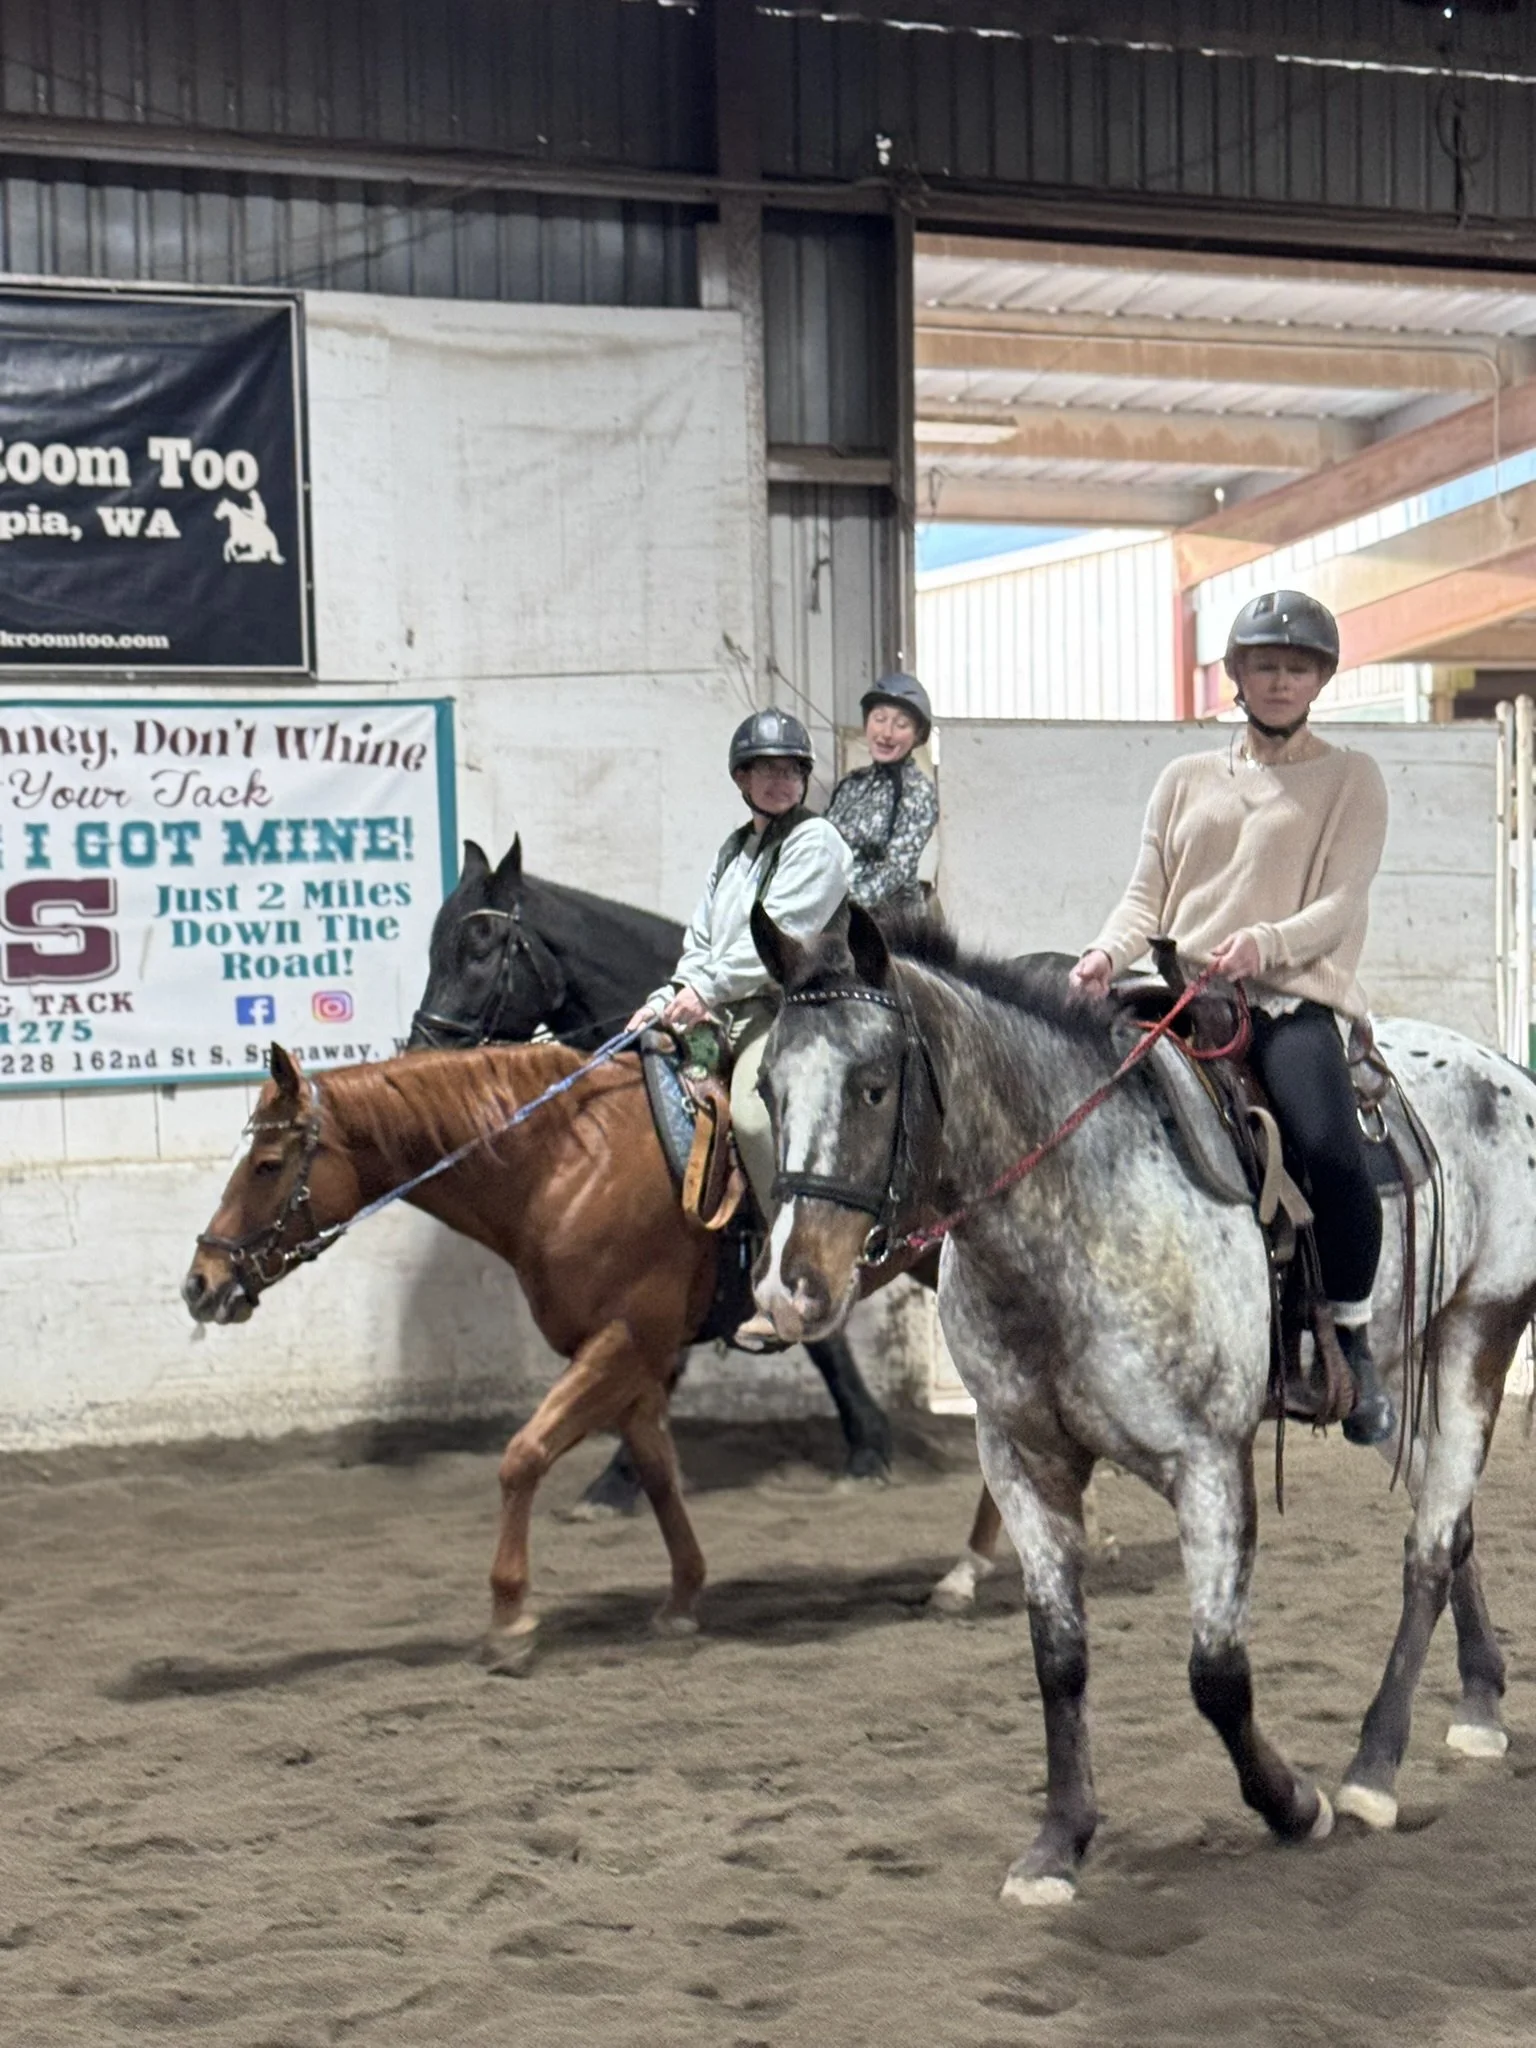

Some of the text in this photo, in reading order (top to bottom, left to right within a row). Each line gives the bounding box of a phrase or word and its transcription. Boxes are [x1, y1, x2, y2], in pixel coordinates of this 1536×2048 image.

[0, 435, 259, 490] oom Too
[0, 503, 181, 542] pia, WA
[134, 717, 256, 758] Don't
[274, 721, 427, 772] Whine
[8, 767, 273, 810] Your Tack
[24, 822, 51, 869] I
[75, 819, 200, 870] GOT
[221, 815, 414, 867] MINE!
[154, 879, 413, 918] Just 2 Miles
[171, 914, 401, 948] Down The
[221, 947, 354, 981] Road!
[33, 991, 134, 1016] TACK
[0, 1019, 94, 1045] 1275
[1, 1054, 55, 1075] 228
[73, 1047, 158, 1072] 162nd
[171, 1046, 197, 1068] St
[244, 1042, 382, 1070] Spnaway,
